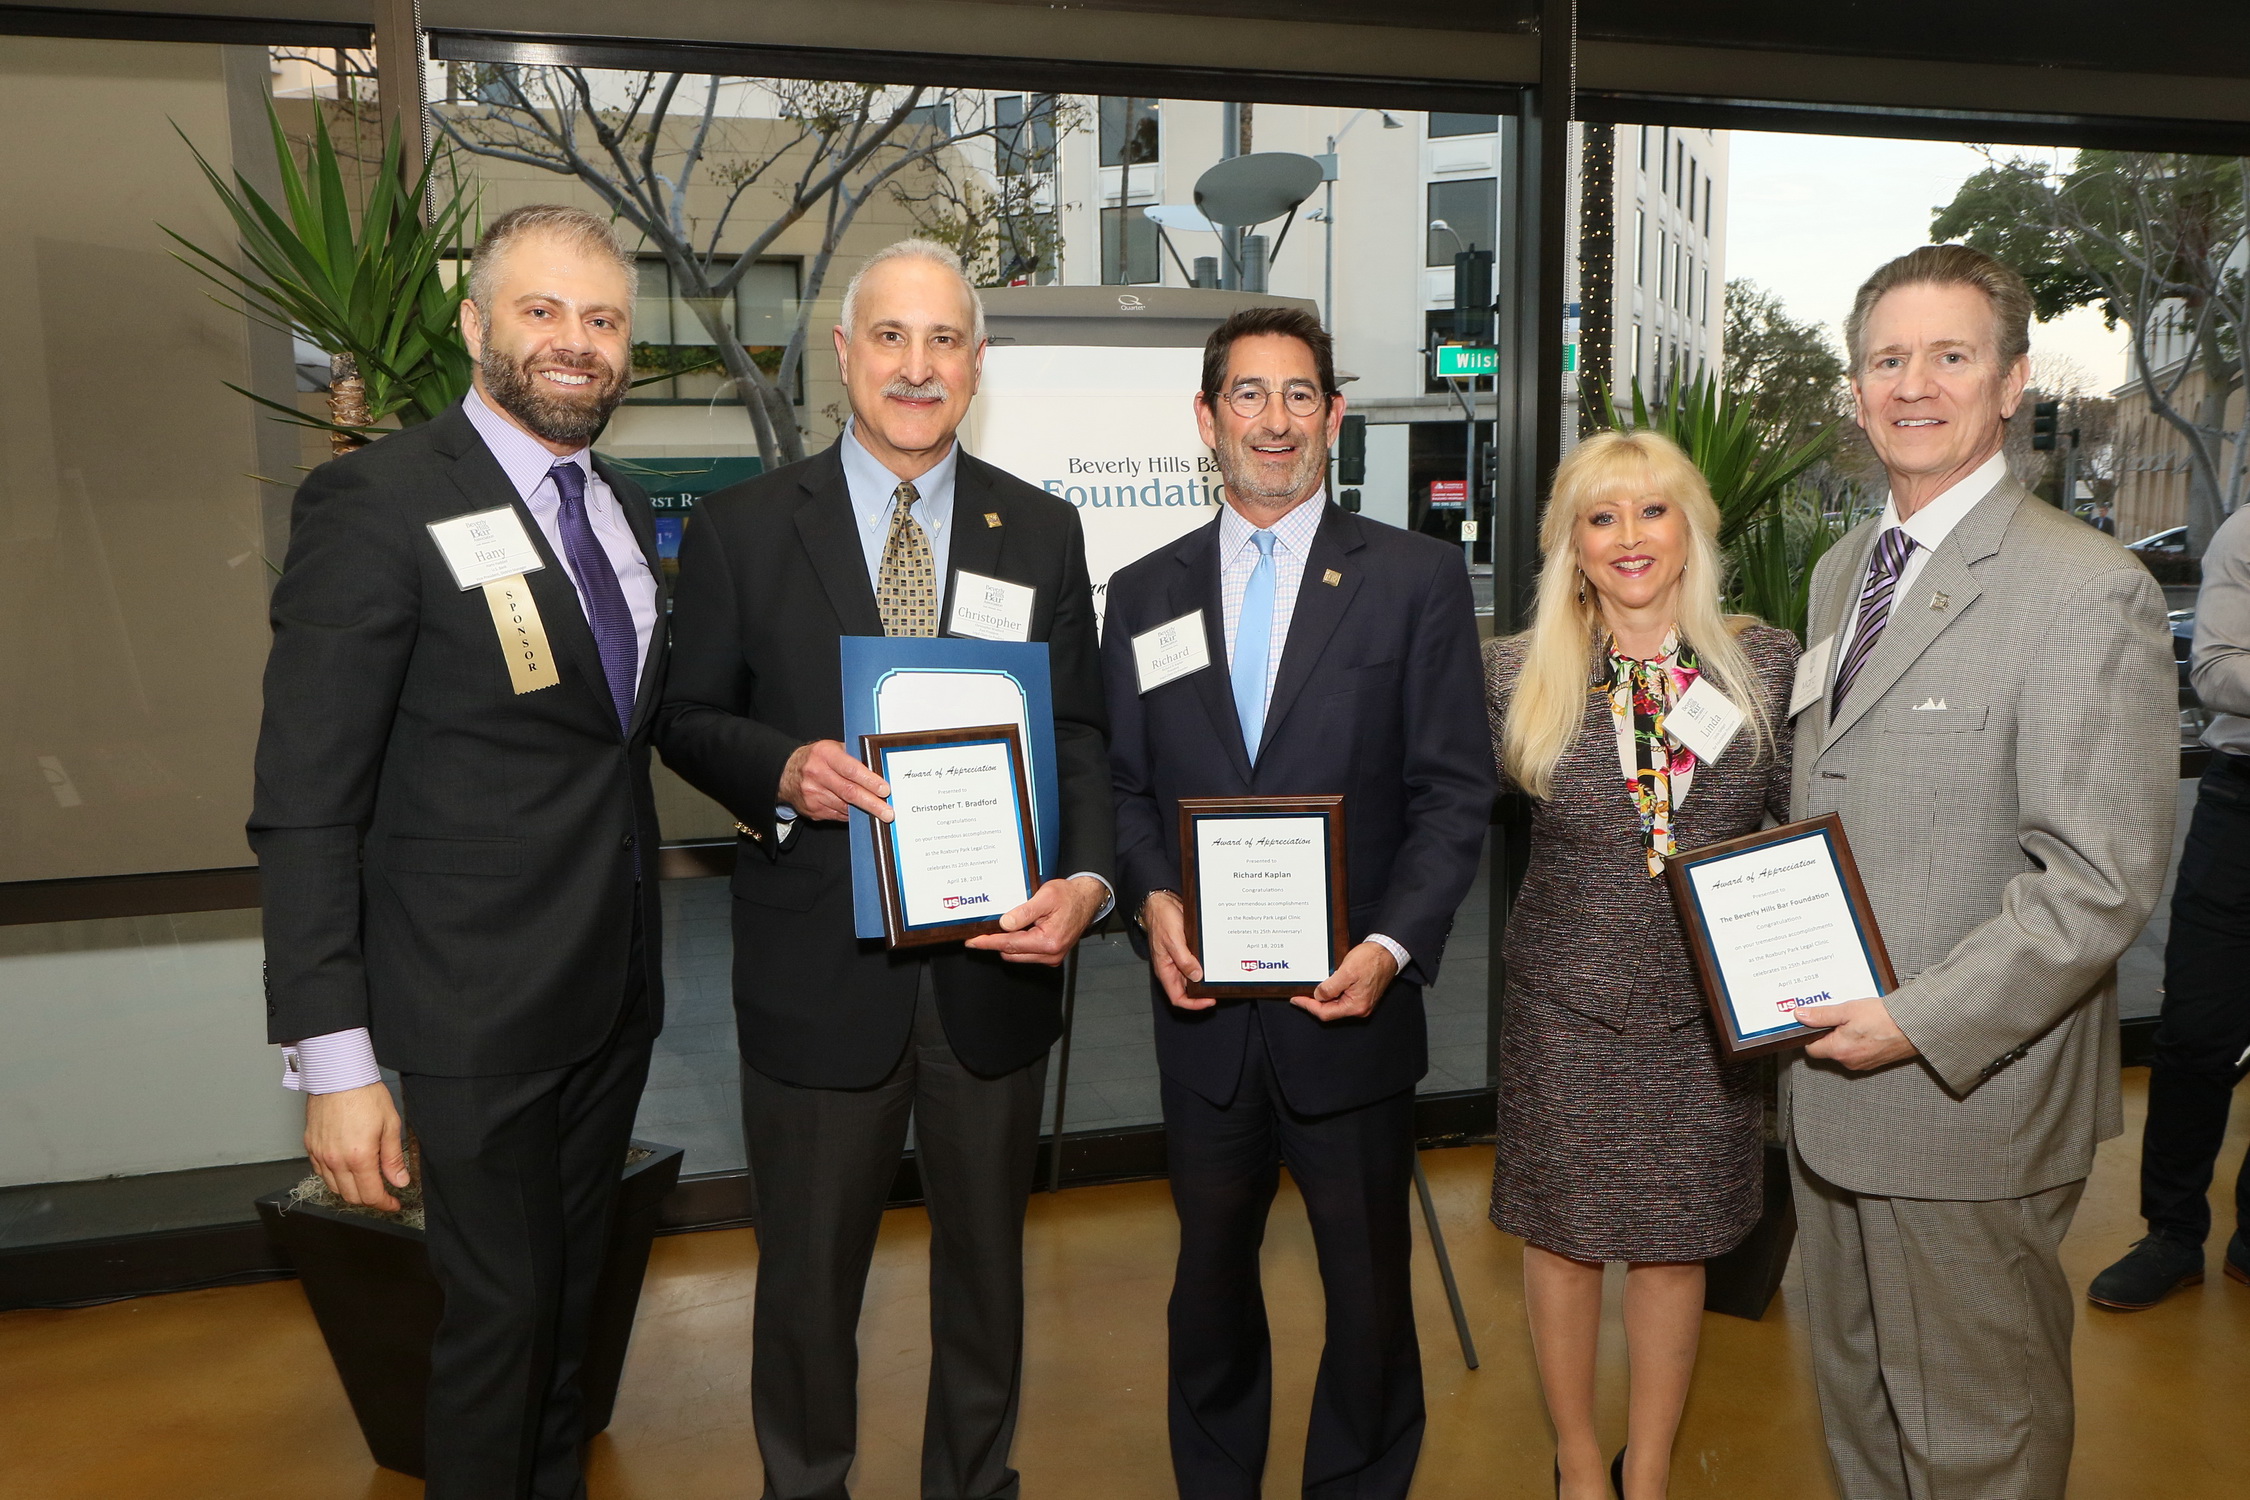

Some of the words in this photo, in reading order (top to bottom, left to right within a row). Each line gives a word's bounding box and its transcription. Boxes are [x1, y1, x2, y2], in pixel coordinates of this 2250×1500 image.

[1069, 457, 1141, 477] Beverly
[1149, 456, 1190, 472] Hills
[1197, 457, 1221, 472] Ba
[1042, 476, 1225, 508] Foundatio
[470, 528, 490, 538] Bar
[475, 548, 506, 562] Hany
[985, 592, 1004, 603] Bar
[958, 607, 1021, 630] Christopher
[506, 590, 537, 672] SPONSOR
[1159, 635, 1177, 646] Bar
[1151, 646, 1190, 670] Richard
[1688, 703, 1702, 718] Bar
[1700, 714, 1722, 738] Linda
[903, 769, 932, 779] Award
[935, 768, 943, 778] of
[945, 765, 996, 776] Appreciation
[911, 803, 955, 813] Christopher
[965, 798, 997, 808] Bradford
[936, 816, 977, 826] Congratulations
[962, 829, 1002, 839] accomplishments
[1211, 838, 1242, 846] Award
[1245, 838, 1253, 848] of
[1256, 837, 1311, 847] Appreciation
[1264, 871, 1291, 879] Kaplan
[1712, 875, 1743, 890] Award
[1746, 872, 1754, 883] of
[1758, 859, 1816, 879] Appreciation
[1752, 888, 1780, 900] Presented
[1734, 909, 1759, 920] Beverly
[1760, 905, 1776, 914] Hills
[1790, 892, 1830, 906] Foundation
[1755, 916, 1802, 930] Congratulations
[1742, 942, 1754, 950] your
[1755, 934, 1788, 946] tremendous
[1788, 922, 1834, 938] accomplishments
[1764, 950, 1788, 959] Roxbury
[1786, 946, 1800, 954] Park
[1799, 942, 1814, 950] Legal
[1752, 966, 1780, 978] celebrates
[1787, 960, 1801, 969] 25th
[1778, 980, 1793, 989] April
[1803, 973, 1819, 982] 2018
